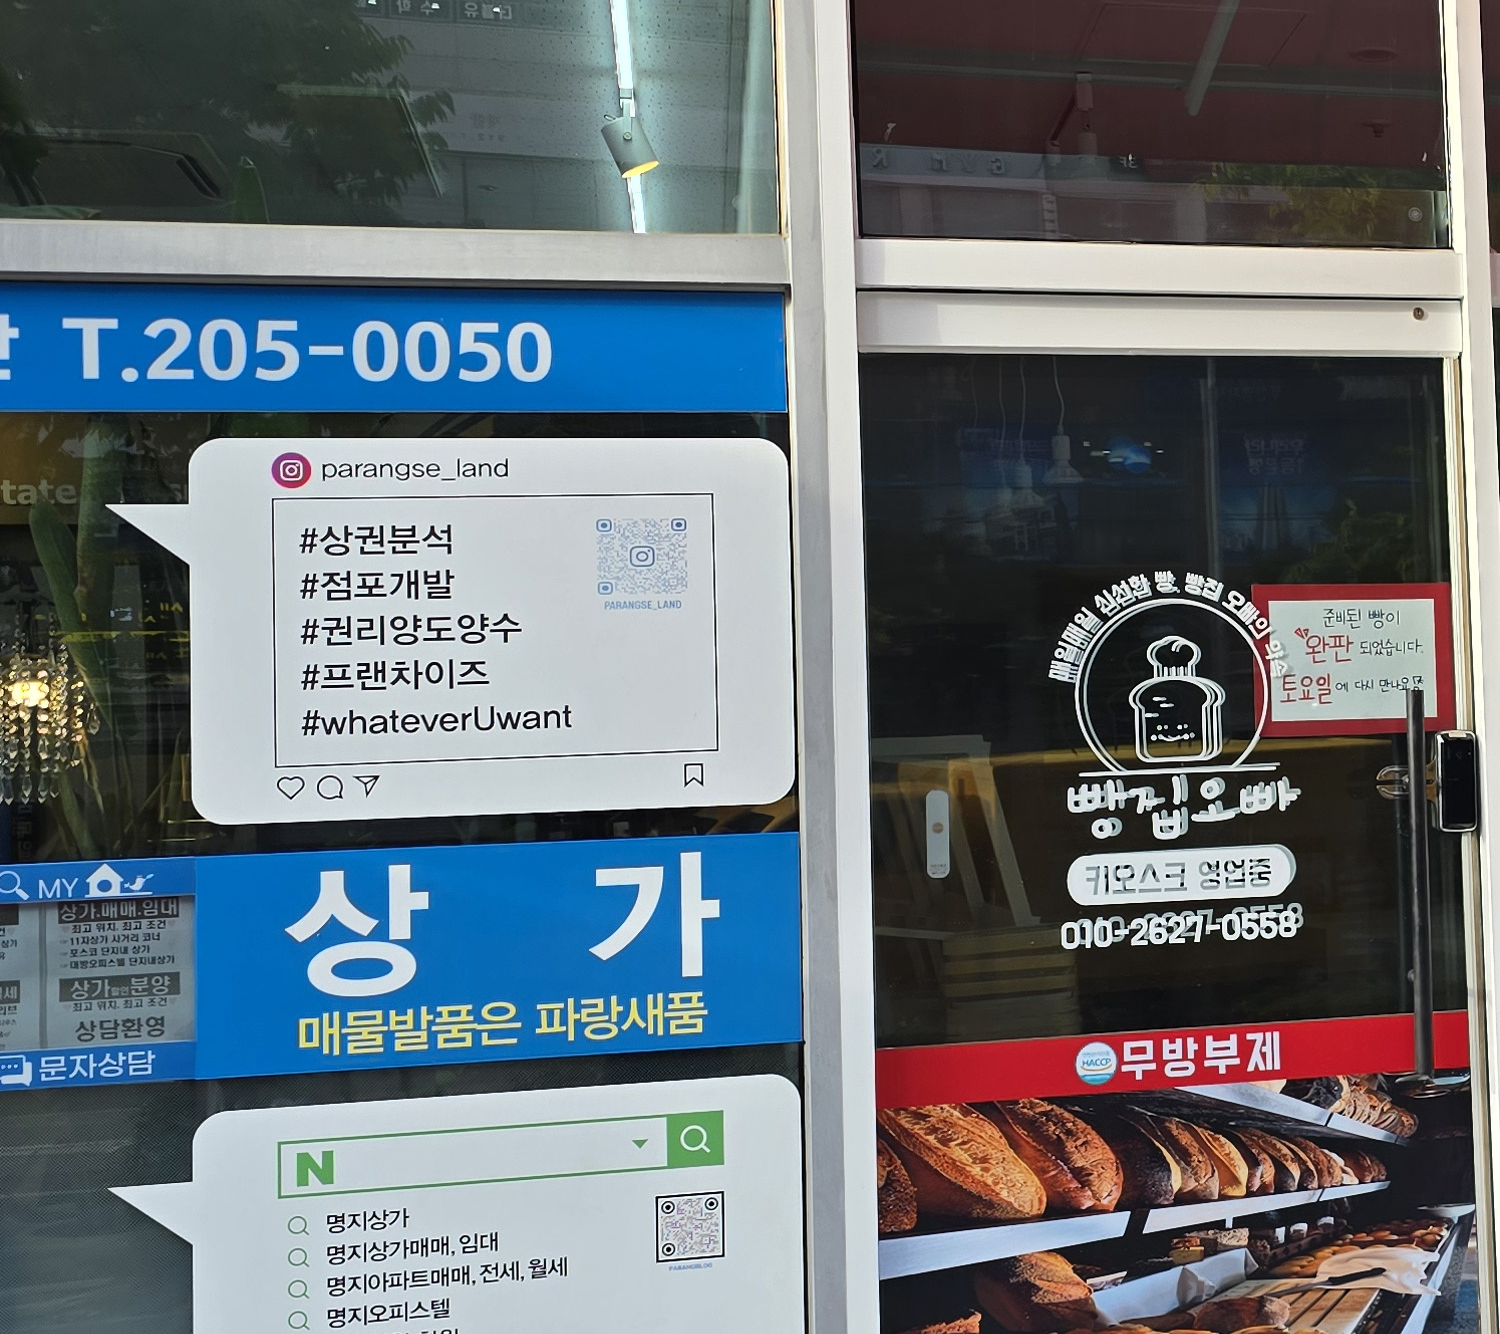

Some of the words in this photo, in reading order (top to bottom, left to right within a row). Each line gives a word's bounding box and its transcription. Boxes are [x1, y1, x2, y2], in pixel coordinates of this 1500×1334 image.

[63, 315, 552, 383] T.205-0050
[320, 457, 509, 482] parangse_land
[299, 524, 454, 557] #상권분석
[299, 568, 455, 603] #점포개발
[603, 599, 682, 611] PARANGSE_LAND
[1185, 572, 1224, 603] 빵집
[1221, 590, 1274, 641] 오빠의
[1322, 608, 1361, 629] 준비된
[1368, 609, 1400, 630] 빵이
[300, 612, 523, 648] #권리양도양수
[1305, 634, 1354, 664] 완판
[300, 659, 490, 693] #프랜차이즈
[1354, 679, 1374, 691] 다시
[301, 704, 572, 740] #whateverUwant
[1067, 774, 1300, 841] 빵집오빠
[38, 877, 78, 899] MY
[1085, 861, 1188, 896] 키오스크
[1060, 908, 1300, 950] 010-2627-0558
[75, 1016, 166, 1043] 상담환영
[298, 1001, 522, 1057] 매물발품은
[535, 991, 709, 1040] 파랑새품
[39, 1050, 156, 1082] 문자상담
[1082, 1057, 1112, 1067] HACCP
[1121, 1030, 1281, 1081] 무방부제
[325, 1208, 410, 1235] 명지상가
[459, 1232, 499, 1257] 임대
[528, 1255, 569, 1280] 월세
[326, 1297, 451, 1329] 명지오피스텔
